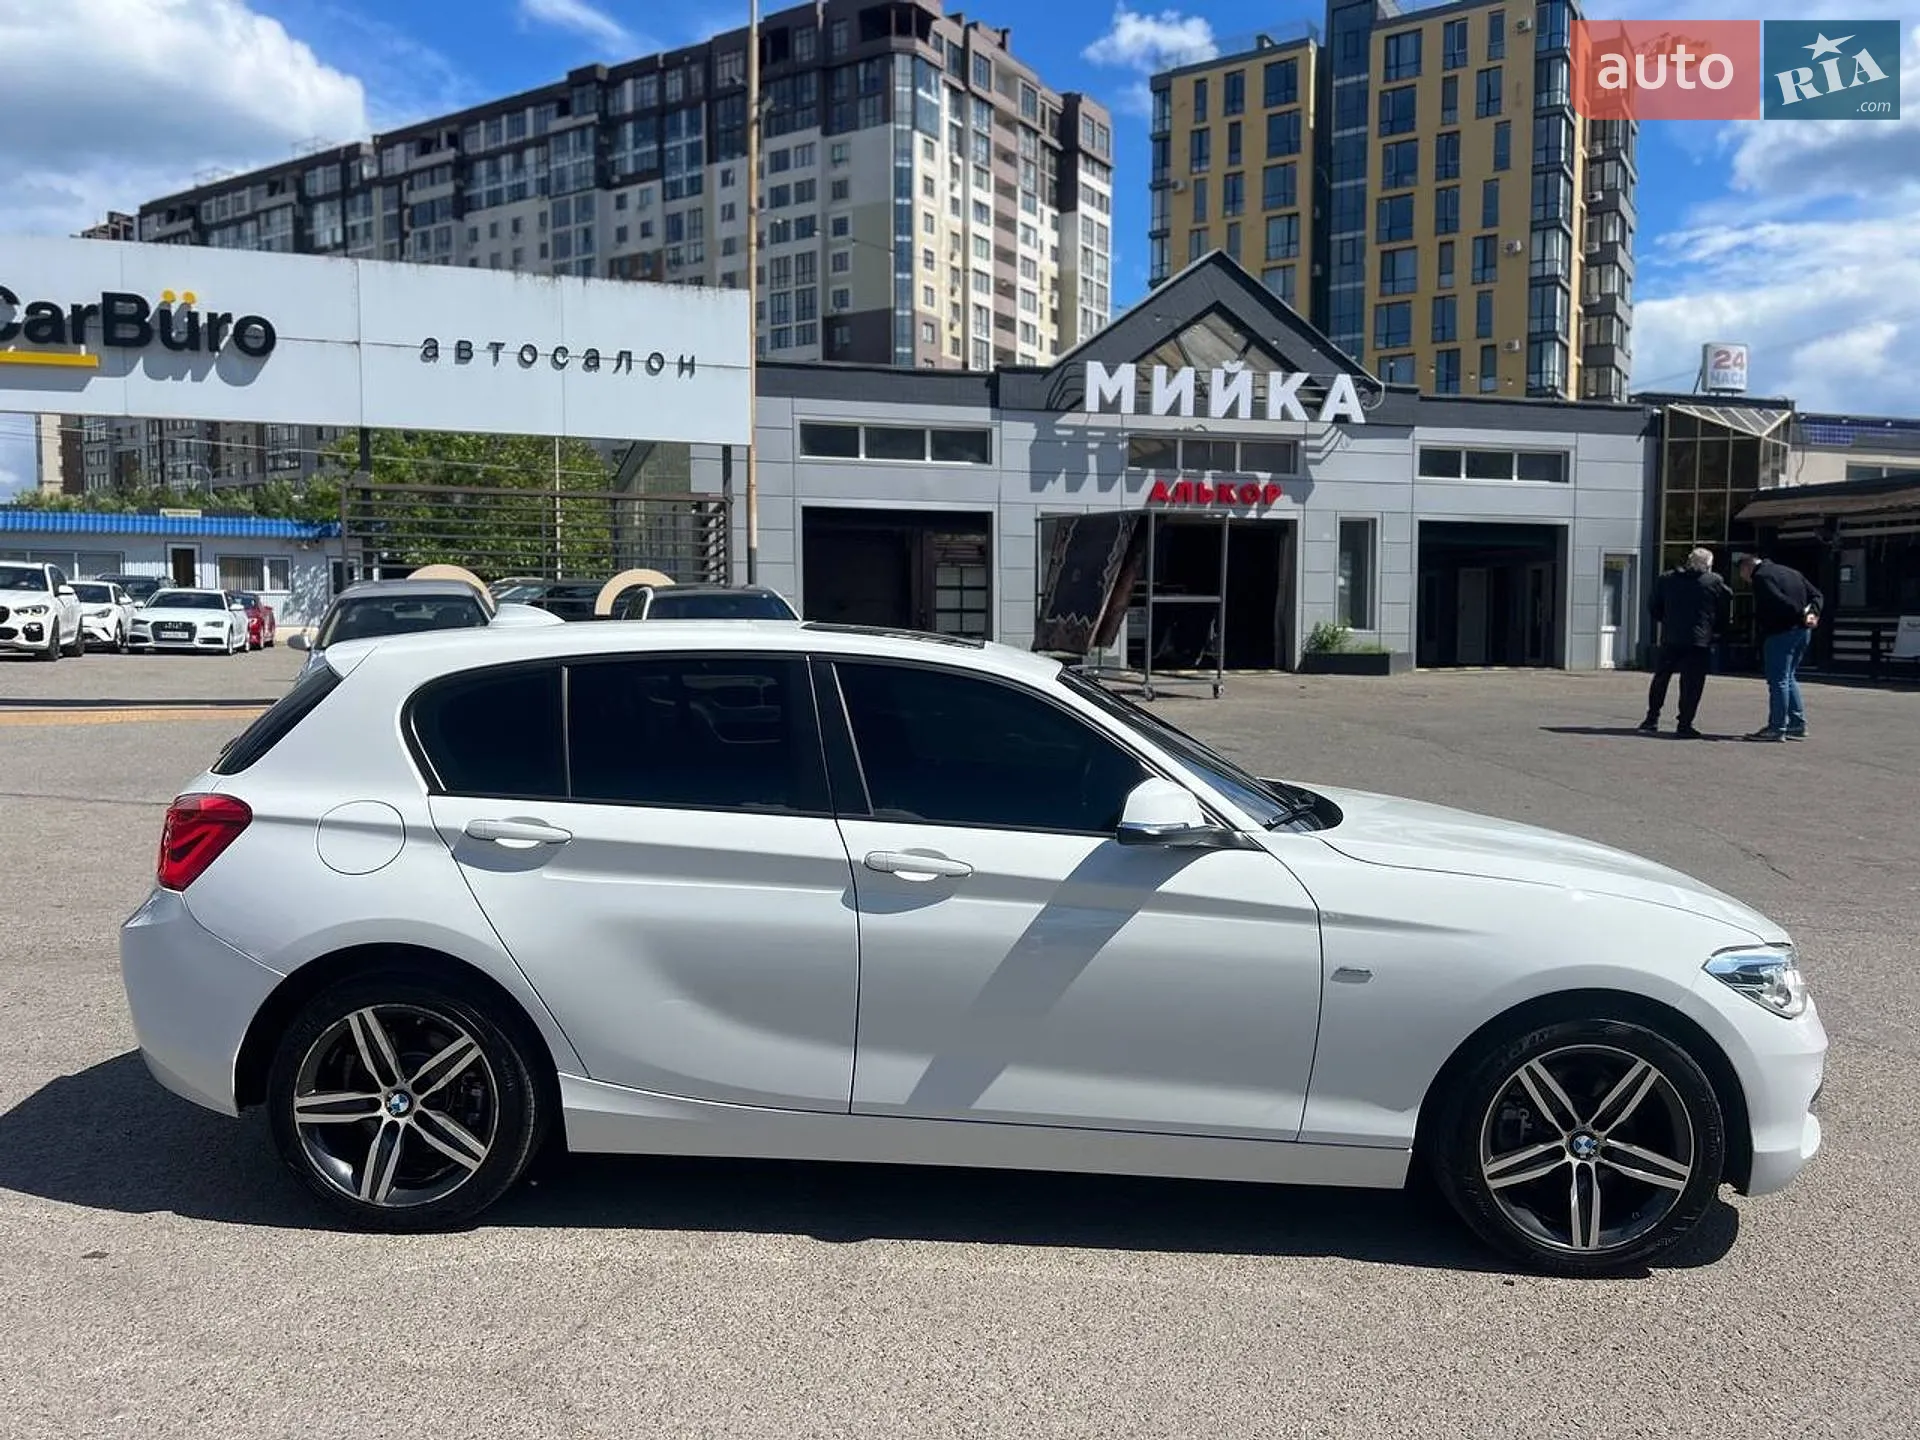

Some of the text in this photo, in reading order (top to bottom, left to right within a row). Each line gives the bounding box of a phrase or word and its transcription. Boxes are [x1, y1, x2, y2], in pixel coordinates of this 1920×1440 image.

[0, 284, 277, 357] CarBüro
[420, 338, 696, 379] автосалон
[1713, 349, 1745, 371] 24
[1085, 360, 1366, 424] МИЙКА
[1149, 479, 1283, 505] АЛЬКОР
